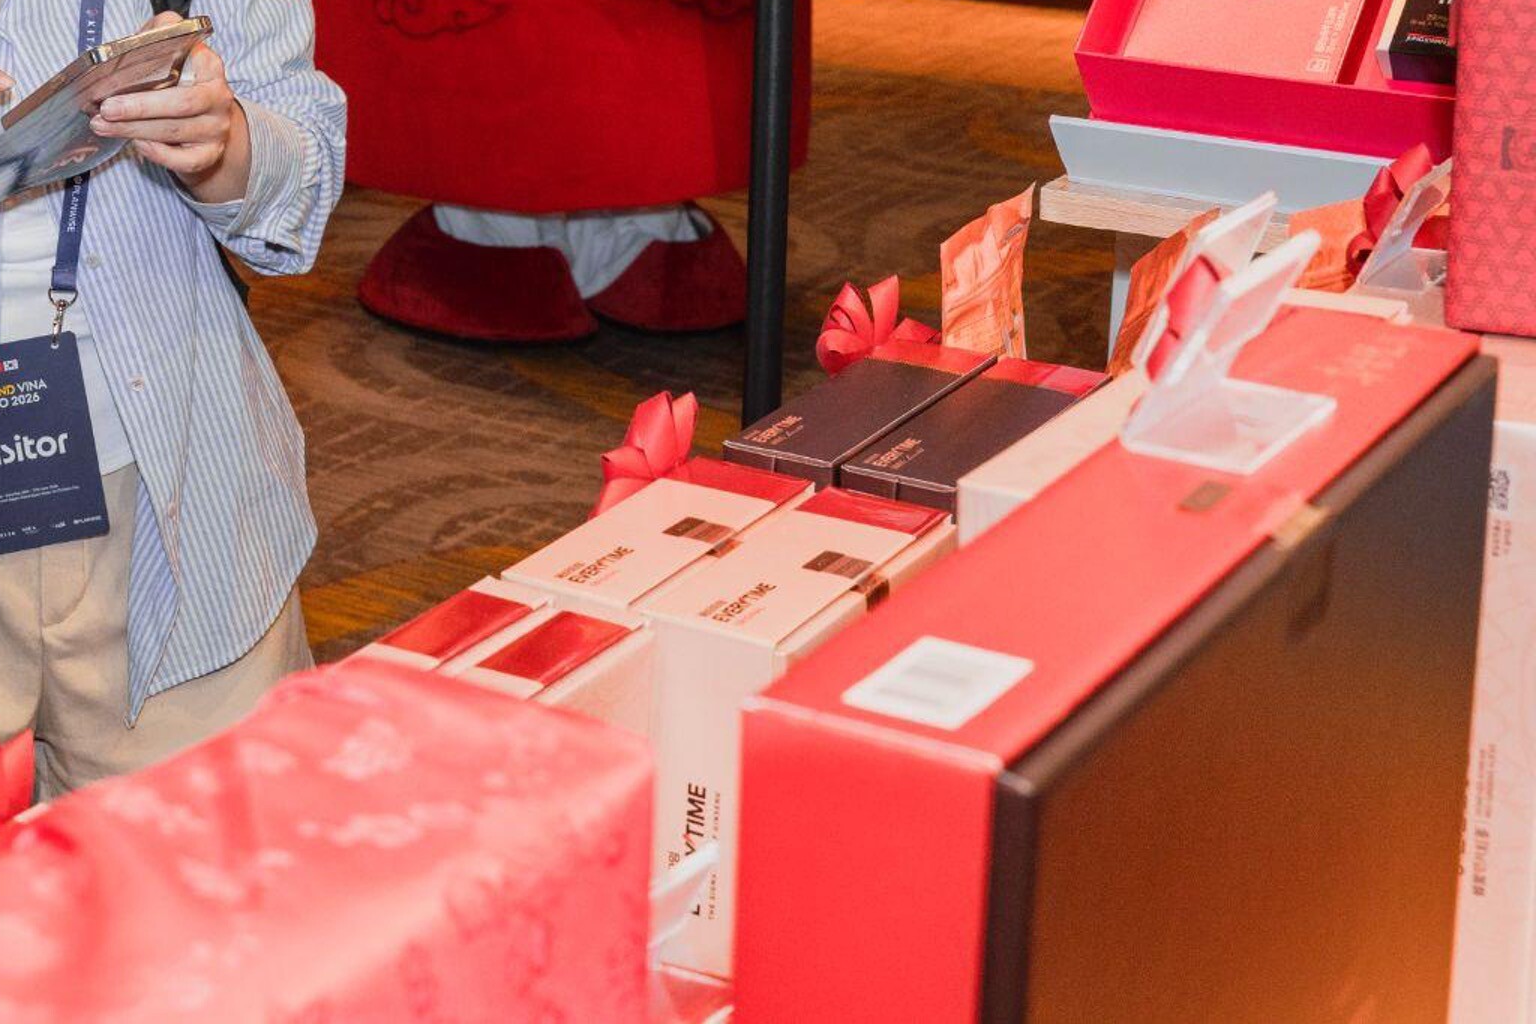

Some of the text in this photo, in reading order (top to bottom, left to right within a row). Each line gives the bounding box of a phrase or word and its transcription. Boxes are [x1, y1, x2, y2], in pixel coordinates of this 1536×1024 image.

[16, 378, 47, 393] VINA
[12, 392, 40, 407] 2026
[568, 546, 635, 584] EVERYTIME
[712, 582, 777, 623] EVERYTIME
